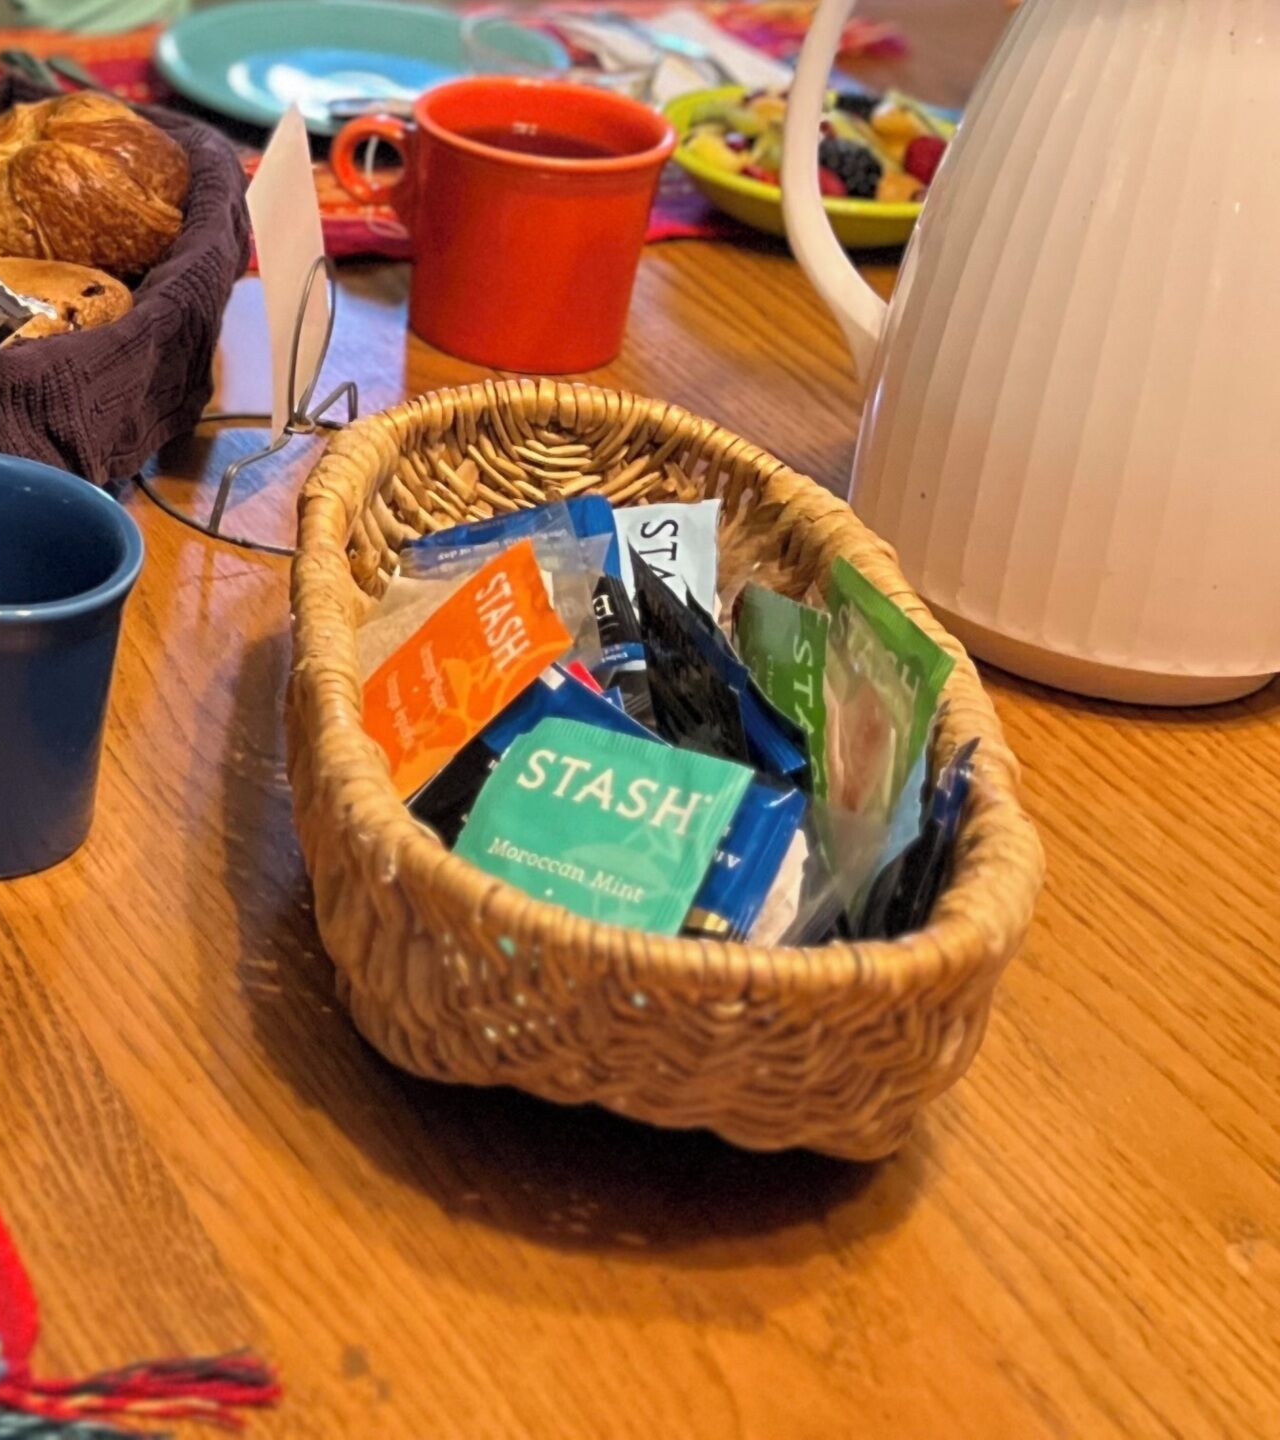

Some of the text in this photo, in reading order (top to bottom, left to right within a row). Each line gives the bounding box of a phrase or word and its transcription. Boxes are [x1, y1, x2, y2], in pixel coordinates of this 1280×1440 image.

[638, 519, 679, 579] STA
[474, 570, 531, 673] STASH
[793, 635, 820, 783] STA
[516, 748, 703, 837] STASH
[487, 837, 646, 904] Moroccan Mint
